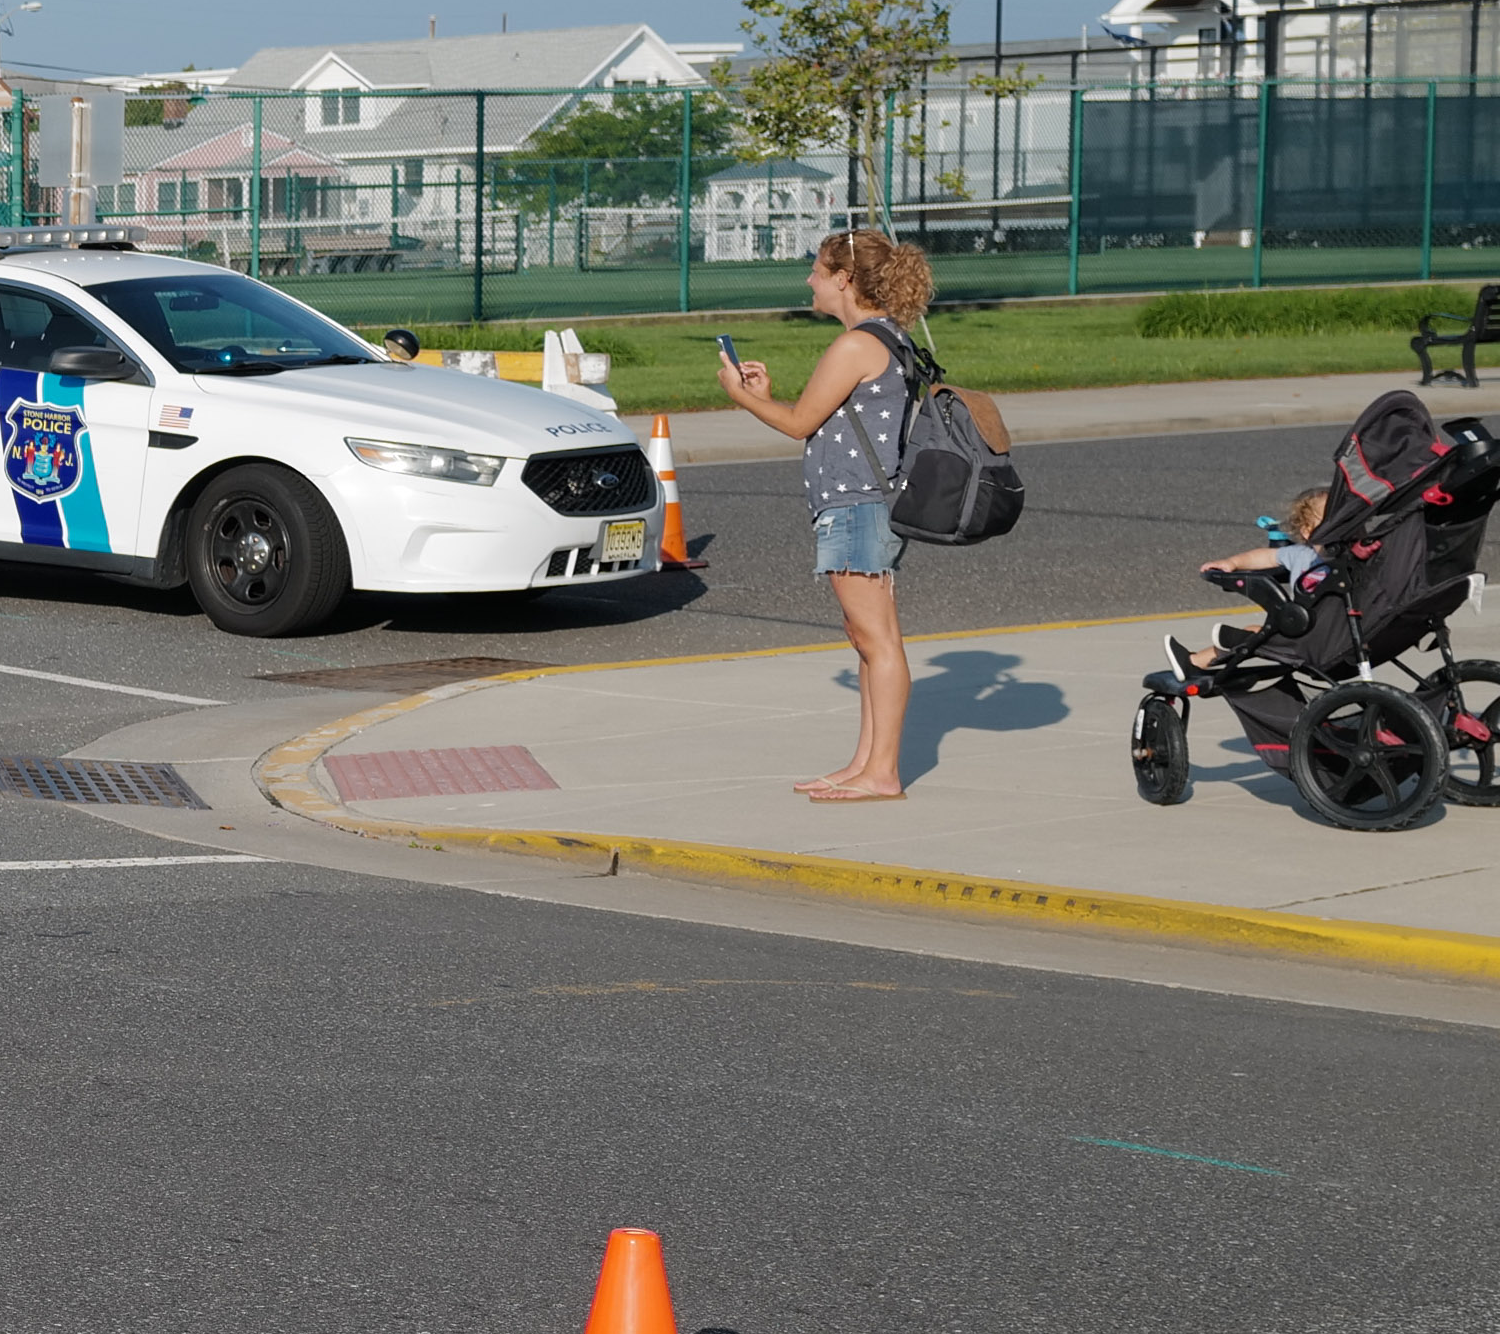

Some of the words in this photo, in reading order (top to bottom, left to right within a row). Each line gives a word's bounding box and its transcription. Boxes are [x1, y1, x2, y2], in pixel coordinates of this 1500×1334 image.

[23, 409, 43, 418] STONE
[44, 412, 71, 422] HARBOR
[23, 418, 72, 434] POLICE
[545, 423, 613, 438] POLICE
[605, 530, 642, 552] 10393MG
